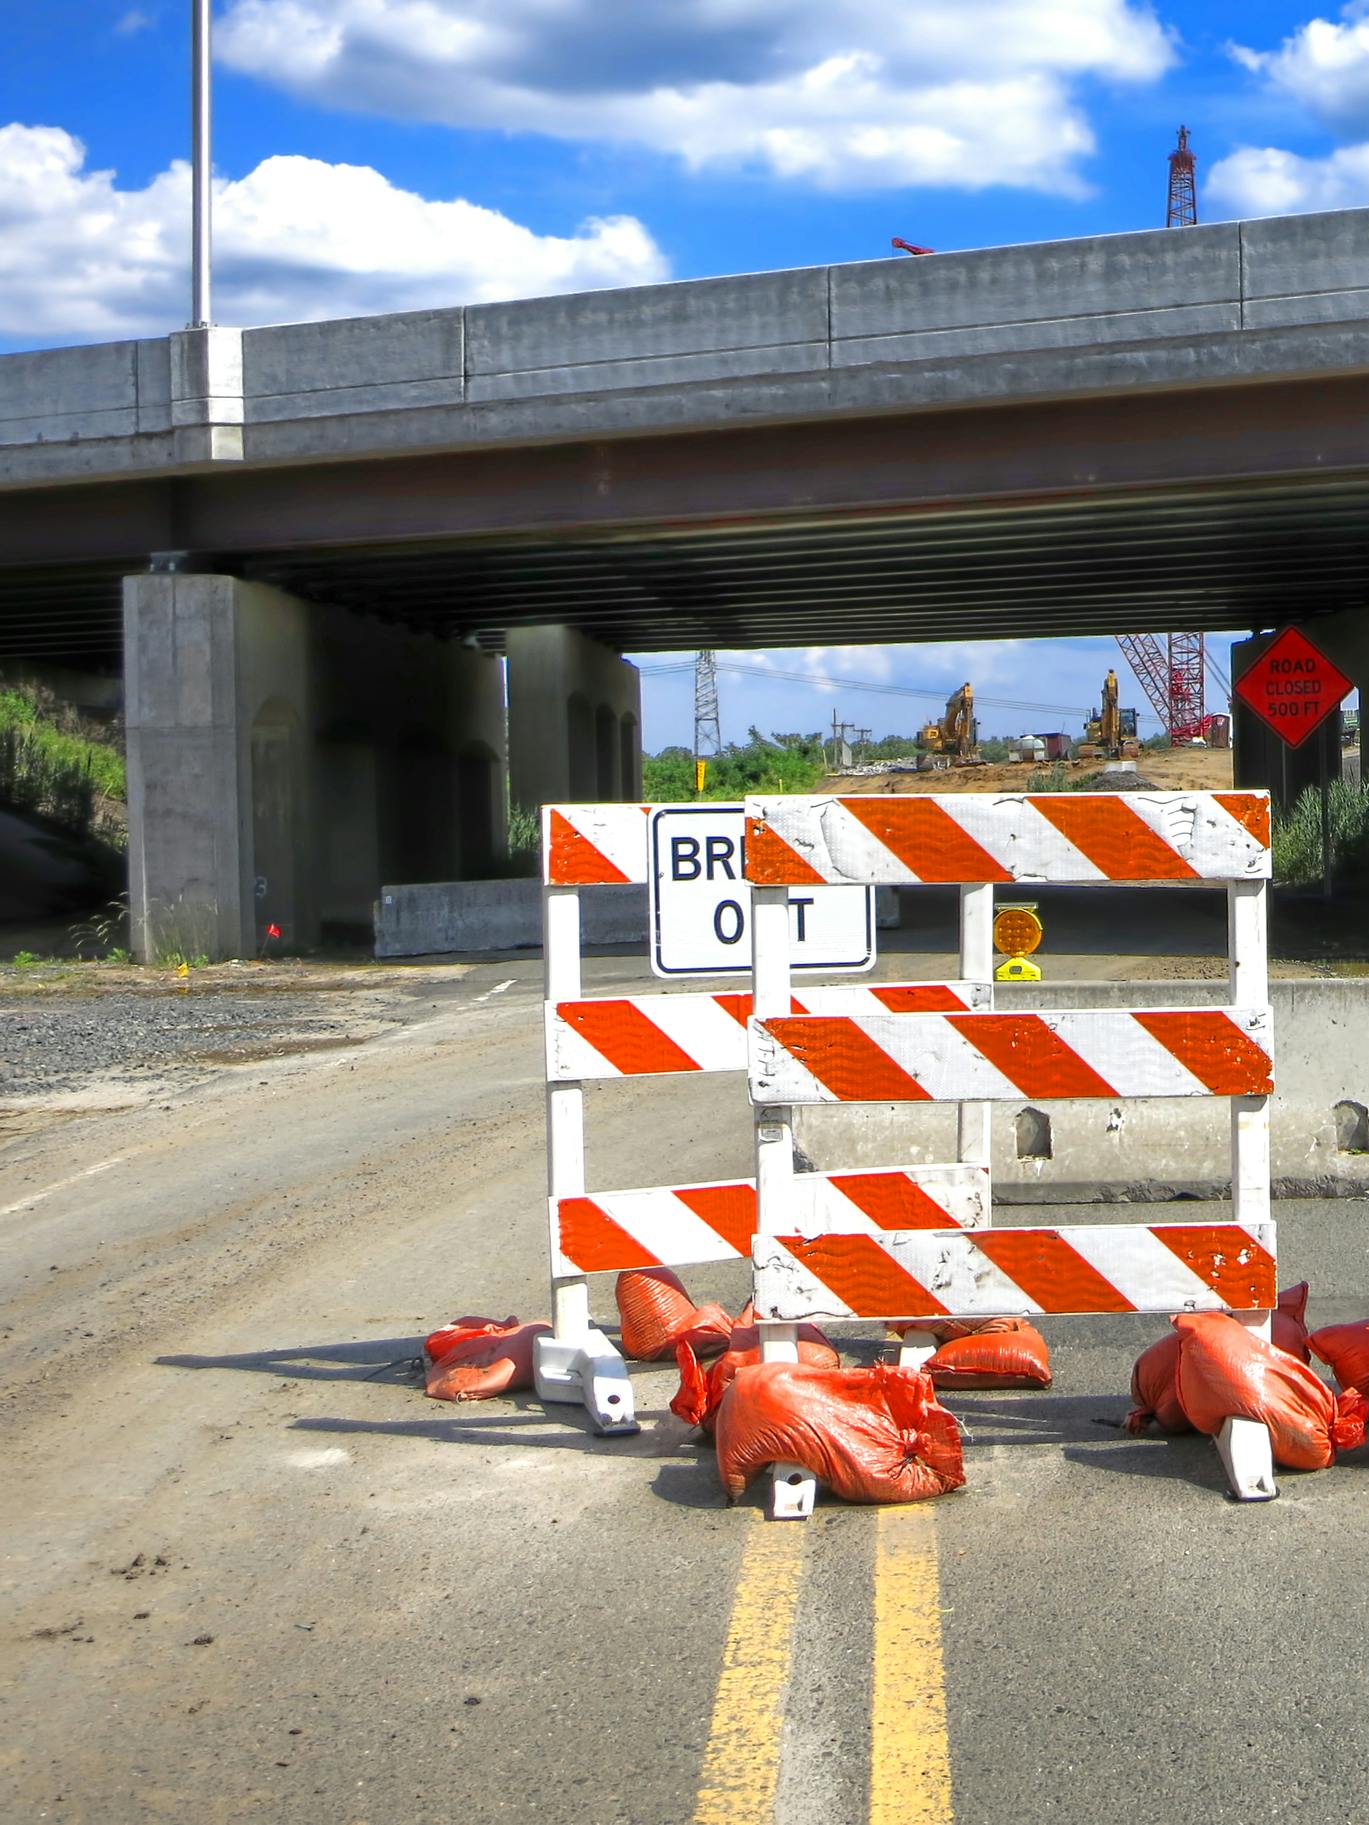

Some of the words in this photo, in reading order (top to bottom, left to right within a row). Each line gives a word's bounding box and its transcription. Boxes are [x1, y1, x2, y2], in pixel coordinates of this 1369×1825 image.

[1270, 658, 1316, 674] ROAD
[1265, 680, 1321, 696] CLOSED
[1268, 702, 1298, 717] 500
[1304, 701, 1319, 716] FT
[713, 898, 814, 945] OT
